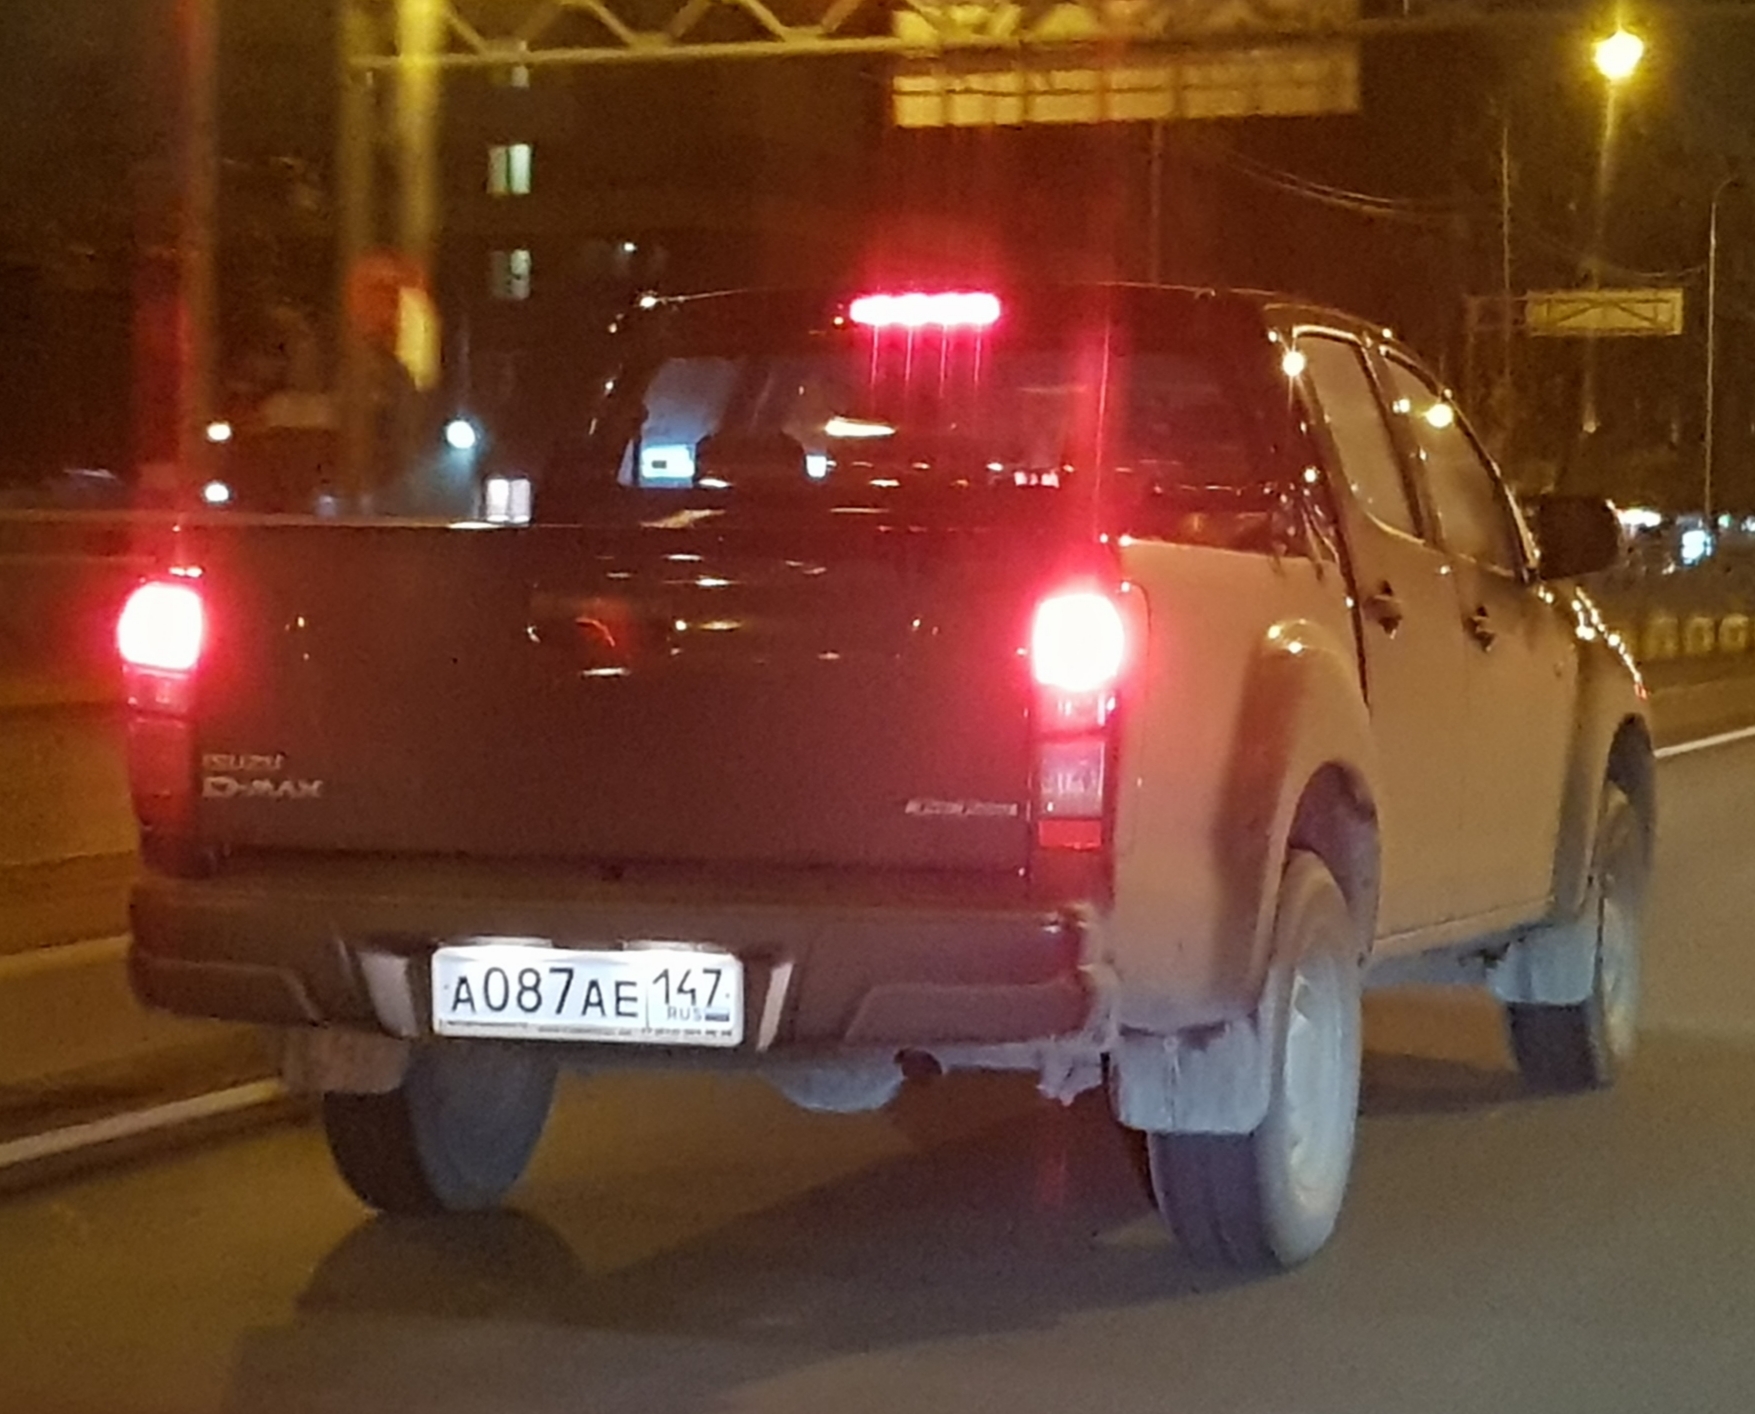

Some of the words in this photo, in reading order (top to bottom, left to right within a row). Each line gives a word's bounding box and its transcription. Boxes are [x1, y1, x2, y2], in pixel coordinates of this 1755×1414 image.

[201, 776, 323, 798] D-MAX
[451, 967, 638, 1018] A087AE
[652, 968, 722, 1007] 147
[667, 1006, 702, 1022] RUS
